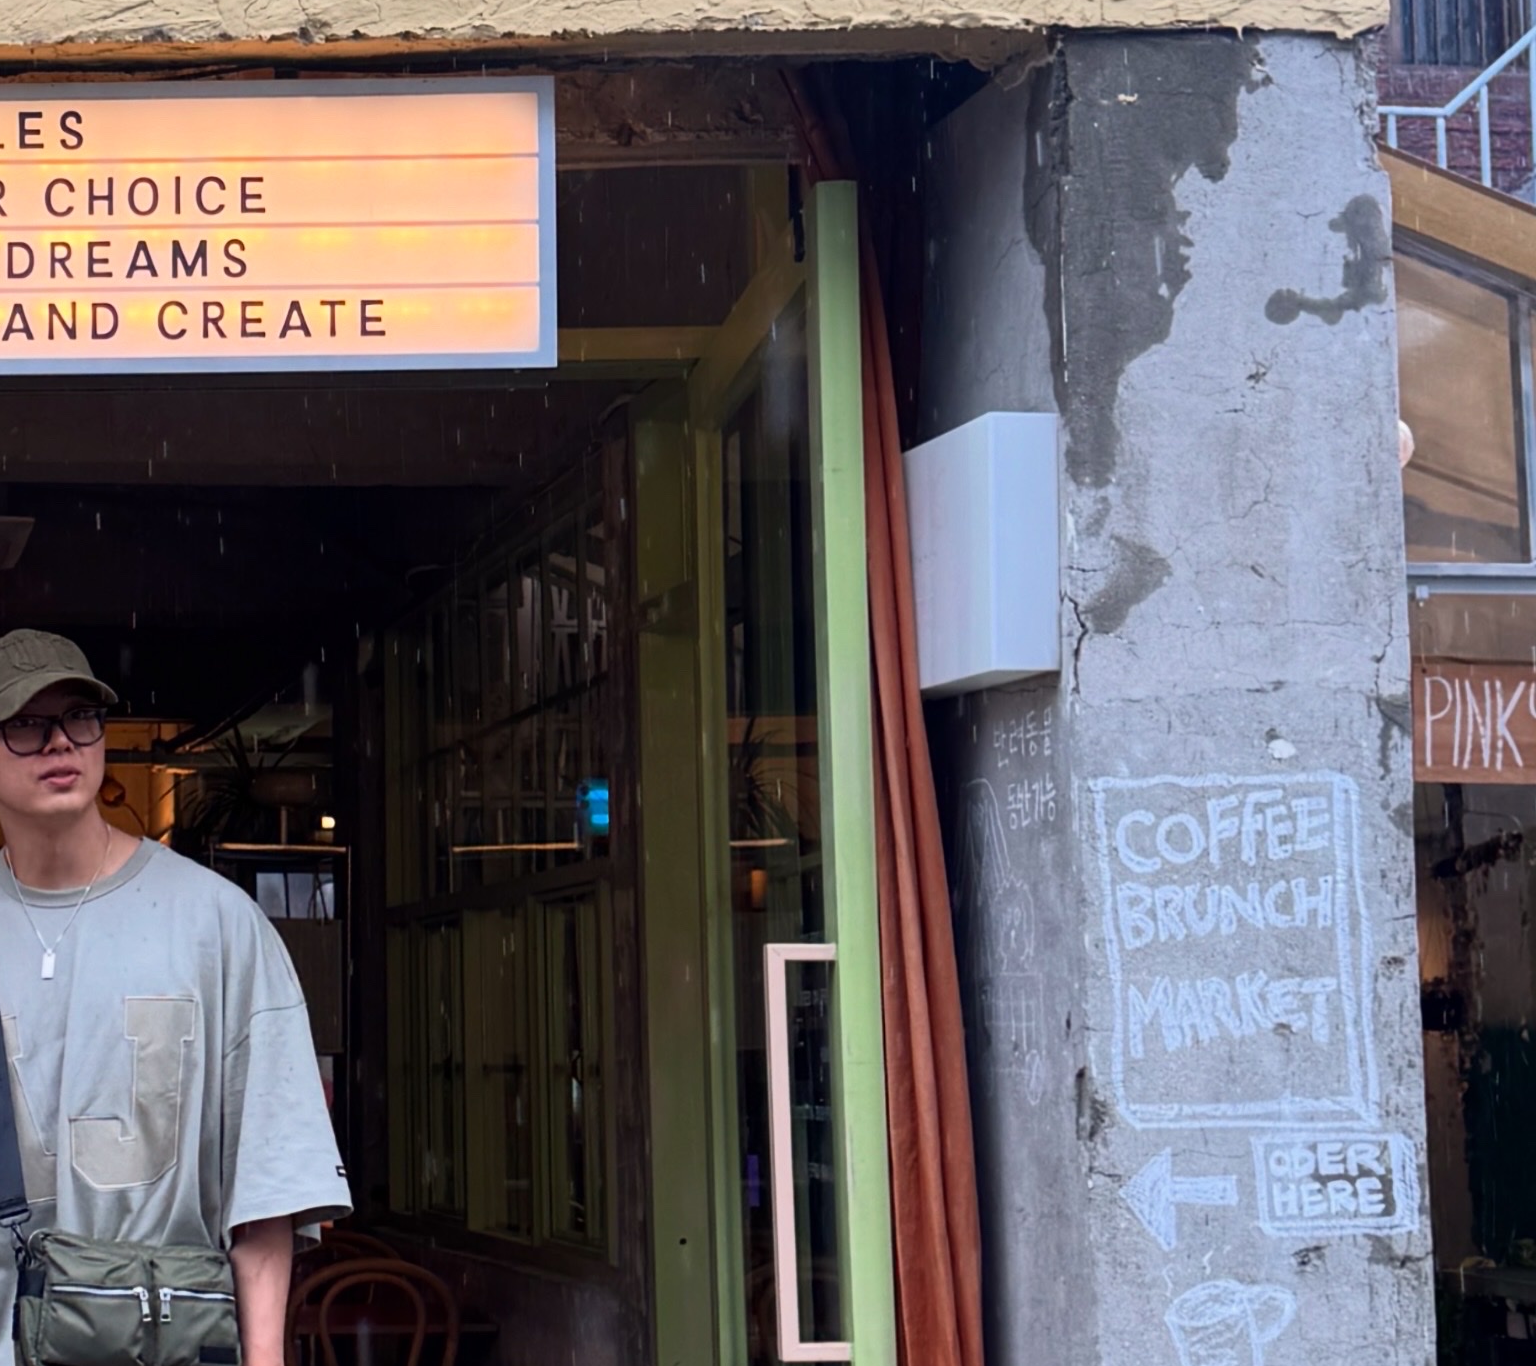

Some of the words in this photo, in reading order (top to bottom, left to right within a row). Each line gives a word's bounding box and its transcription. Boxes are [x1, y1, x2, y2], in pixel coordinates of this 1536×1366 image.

[44, 175, 266, 217] CHOICE
[7, 238, 247, 279] DREAMS
[1, 301, 119, 342] AND
[157, 299, 386, 340] CREATE
[1424, 675, 1536, 771] PINK
[1115, 788, 1330, 873] COFFEE
[1116, 875, 1333, 950] BRUNCH
[1128, 969, 1337, 1059] MARKET
[1269, 1142, 1386, 1177] ODER
[1272, 1177, 1386, 1217] HERE
